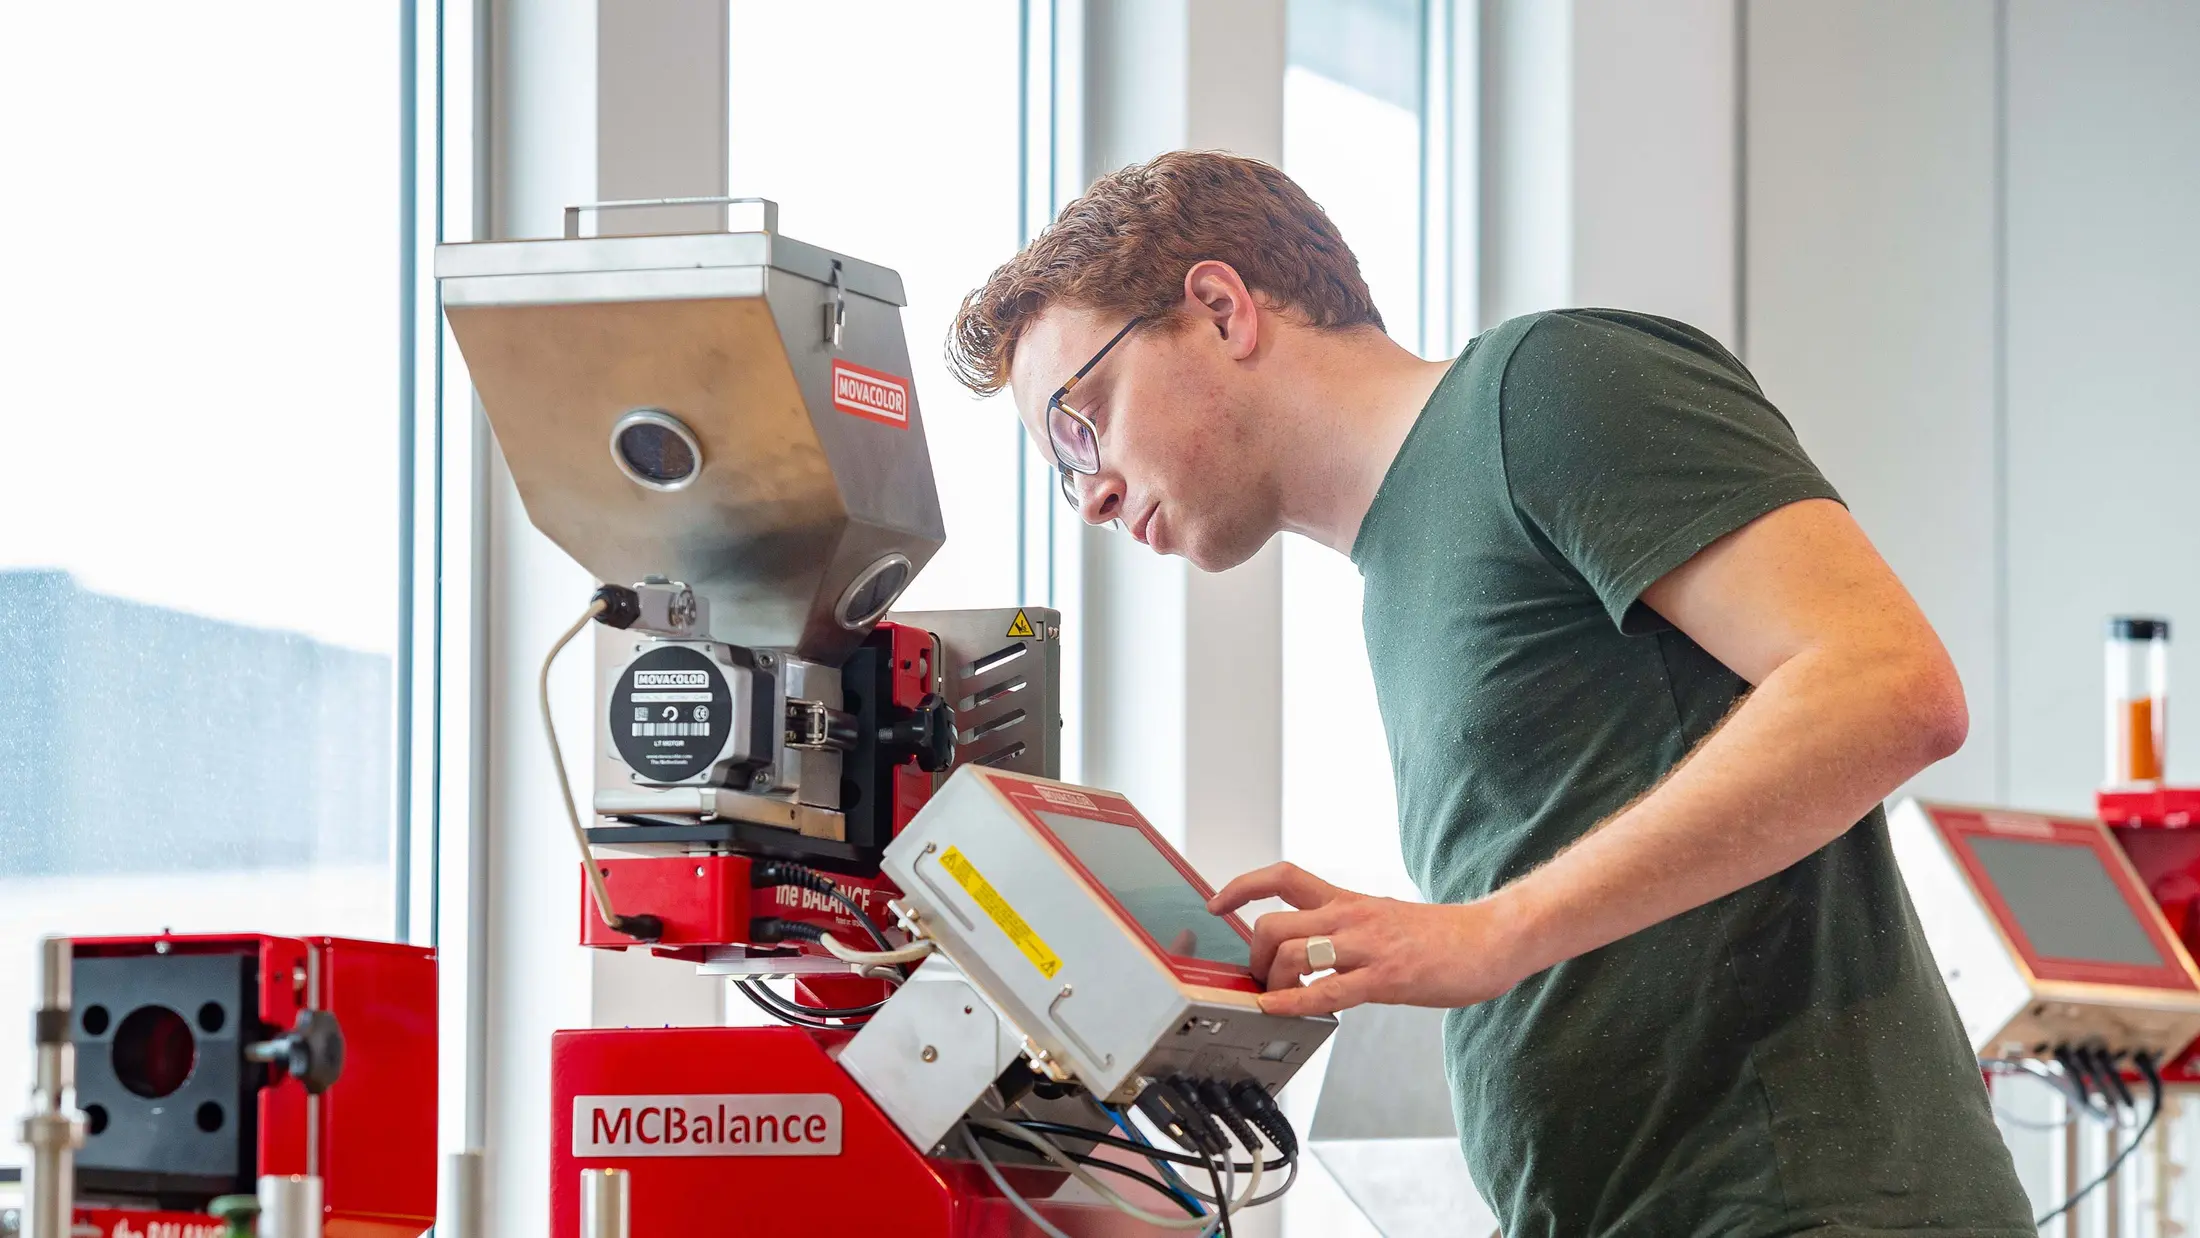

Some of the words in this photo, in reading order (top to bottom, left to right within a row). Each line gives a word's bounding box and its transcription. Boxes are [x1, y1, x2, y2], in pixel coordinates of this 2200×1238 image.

[839, 376, 902, 411] MOVACOLOR
[638, 674, 704, 685] MOVACOLOR
[592, 1104, 827, 1144] MCBalance
